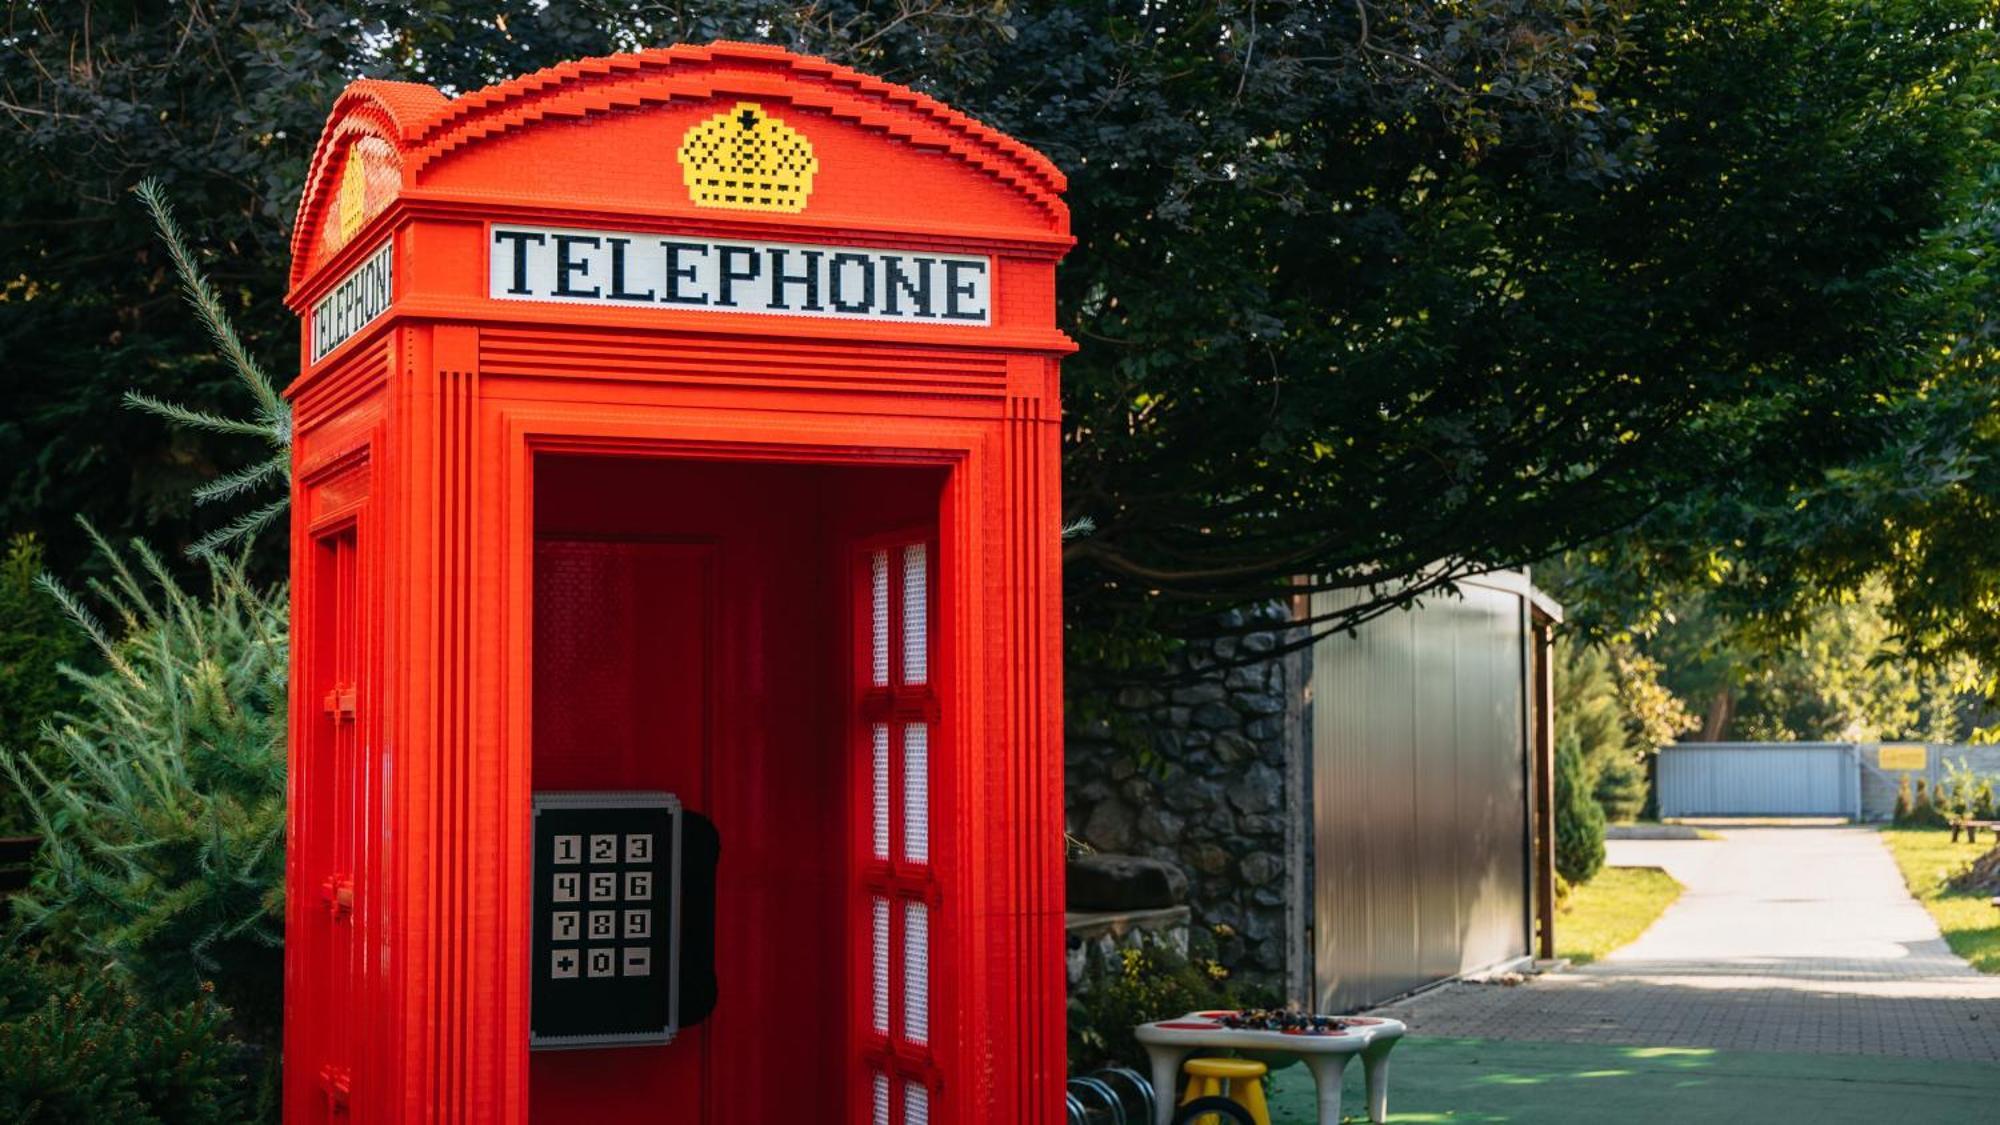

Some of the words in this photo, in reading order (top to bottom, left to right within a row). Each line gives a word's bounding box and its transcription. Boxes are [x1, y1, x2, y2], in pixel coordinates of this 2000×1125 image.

[495, 231, 985, 319] TELEPHONE
[559, 839, 575, 860] 1
[595, 839, 612, 859] 2
[631, 838, 648, 858] 3
[559, 877, 575, 897] 4
[595, 877, 611, 897] 5
[630, 876, 647, 896] 6
[558, 915, 575, 935] 7
[594, 915, 610, 935] 8
[629, 913, 646, 934] 9
[593, 953, 610, 973] 0
